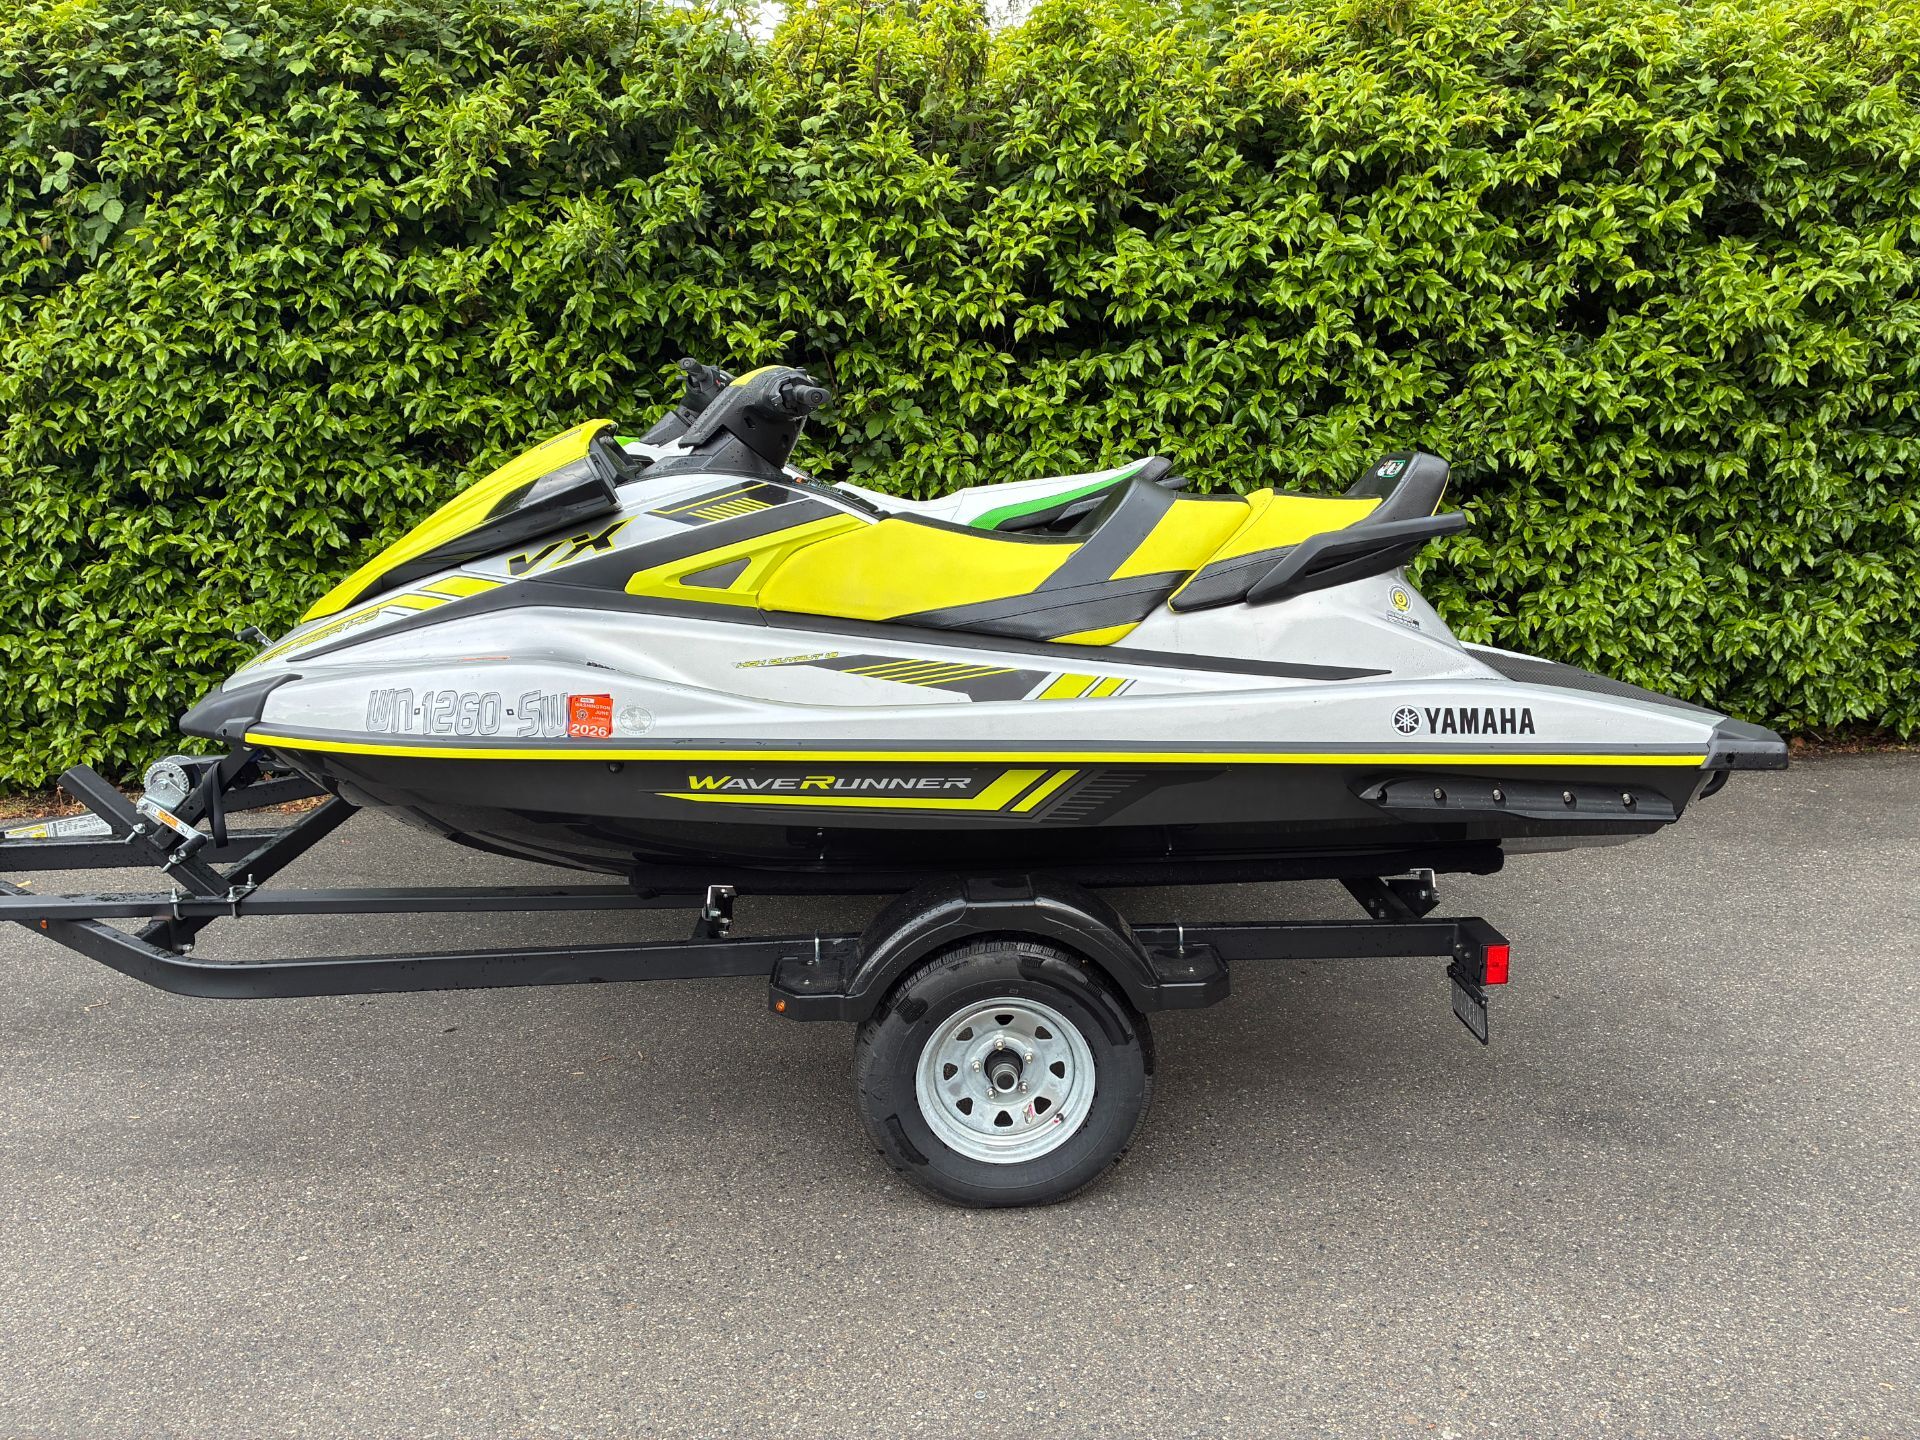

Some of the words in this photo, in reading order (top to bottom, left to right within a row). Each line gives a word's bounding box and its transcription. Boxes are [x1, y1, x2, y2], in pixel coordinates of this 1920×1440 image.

[507, 514, 639, 577] VX
[571, 723, 607, 737] 2026
[1424, 707, 1536, 735] YAMAHA
